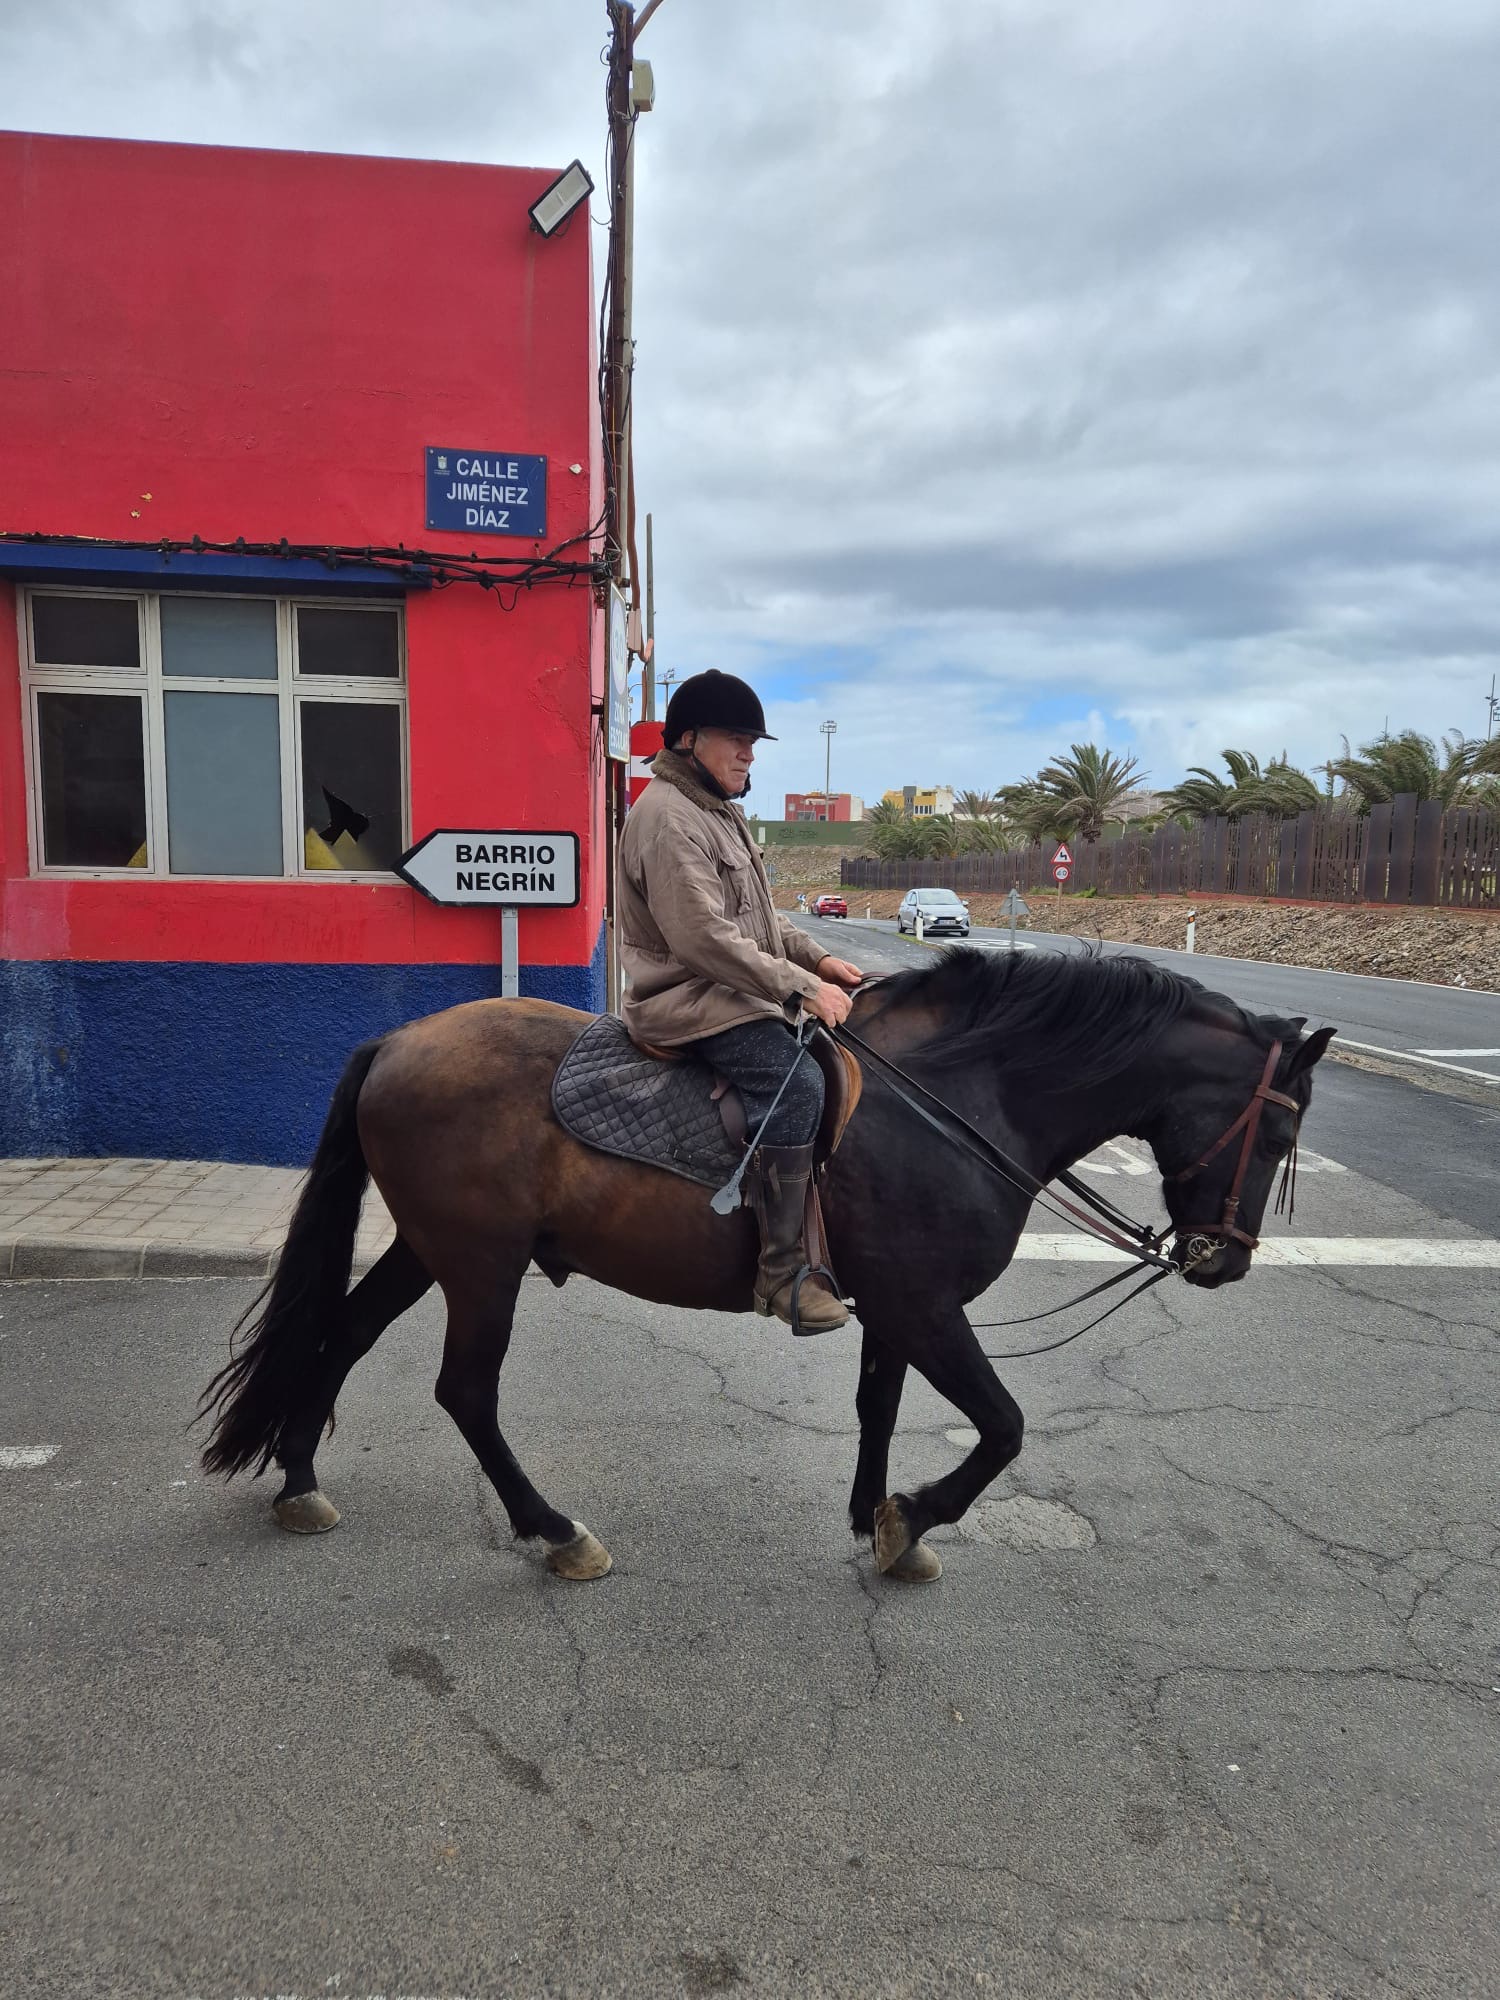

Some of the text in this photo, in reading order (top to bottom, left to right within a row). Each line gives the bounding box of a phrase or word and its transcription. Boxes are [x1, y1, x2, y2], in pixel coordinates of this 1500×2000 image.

[456, 458, 519, 479] CALLE
[446, 481, 529, 505] JIMÉNEZ
[465, 505, 510, 528] DÍAZ
[455, 844, 555, 865] BARRIO
[456, 867, 555, 891] NEGRÍN
